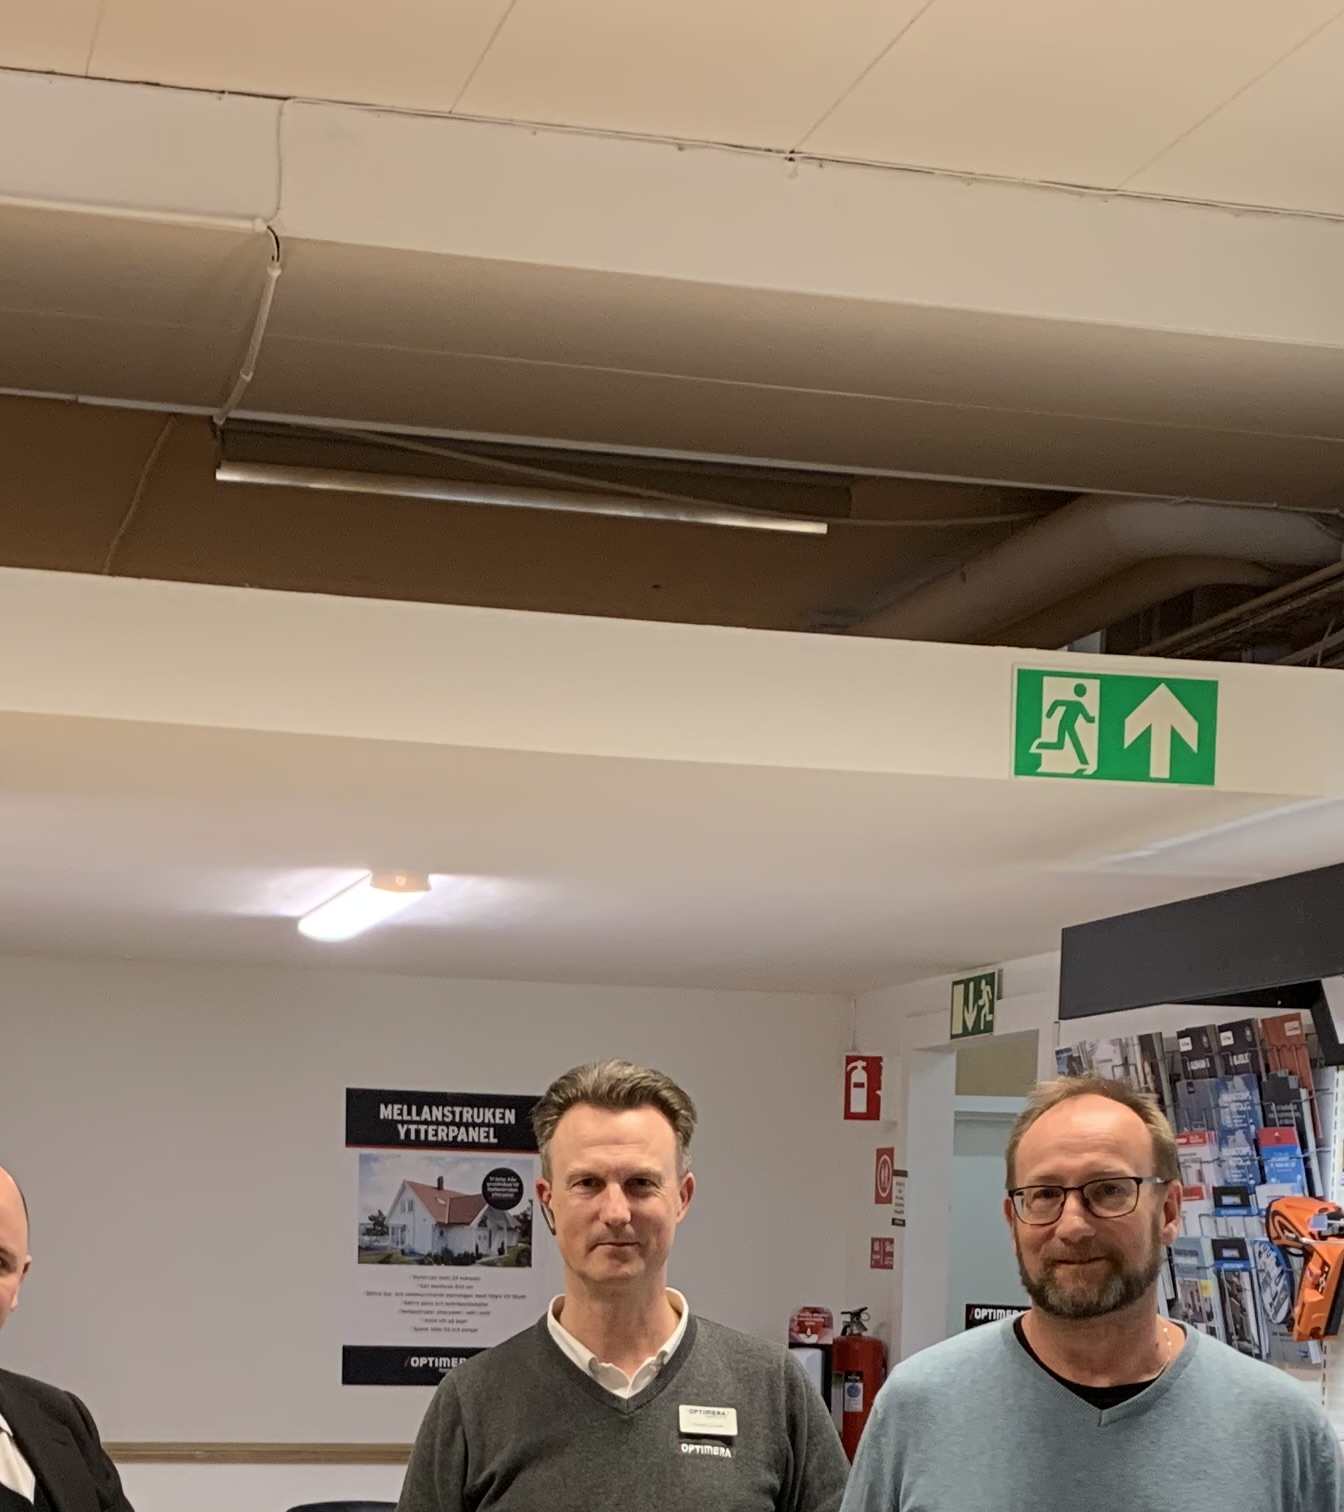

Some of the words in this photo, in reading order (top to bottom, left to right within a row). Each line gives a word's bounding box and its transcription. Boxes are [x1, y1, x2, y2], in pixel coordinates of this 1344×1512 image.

[379, 1103, 516, 1125] MELLANSTRUKEN
[397, 1123, 499, 1144] YTTERPANEL
[681, 1443, 732, 1458] OPTIMERA
